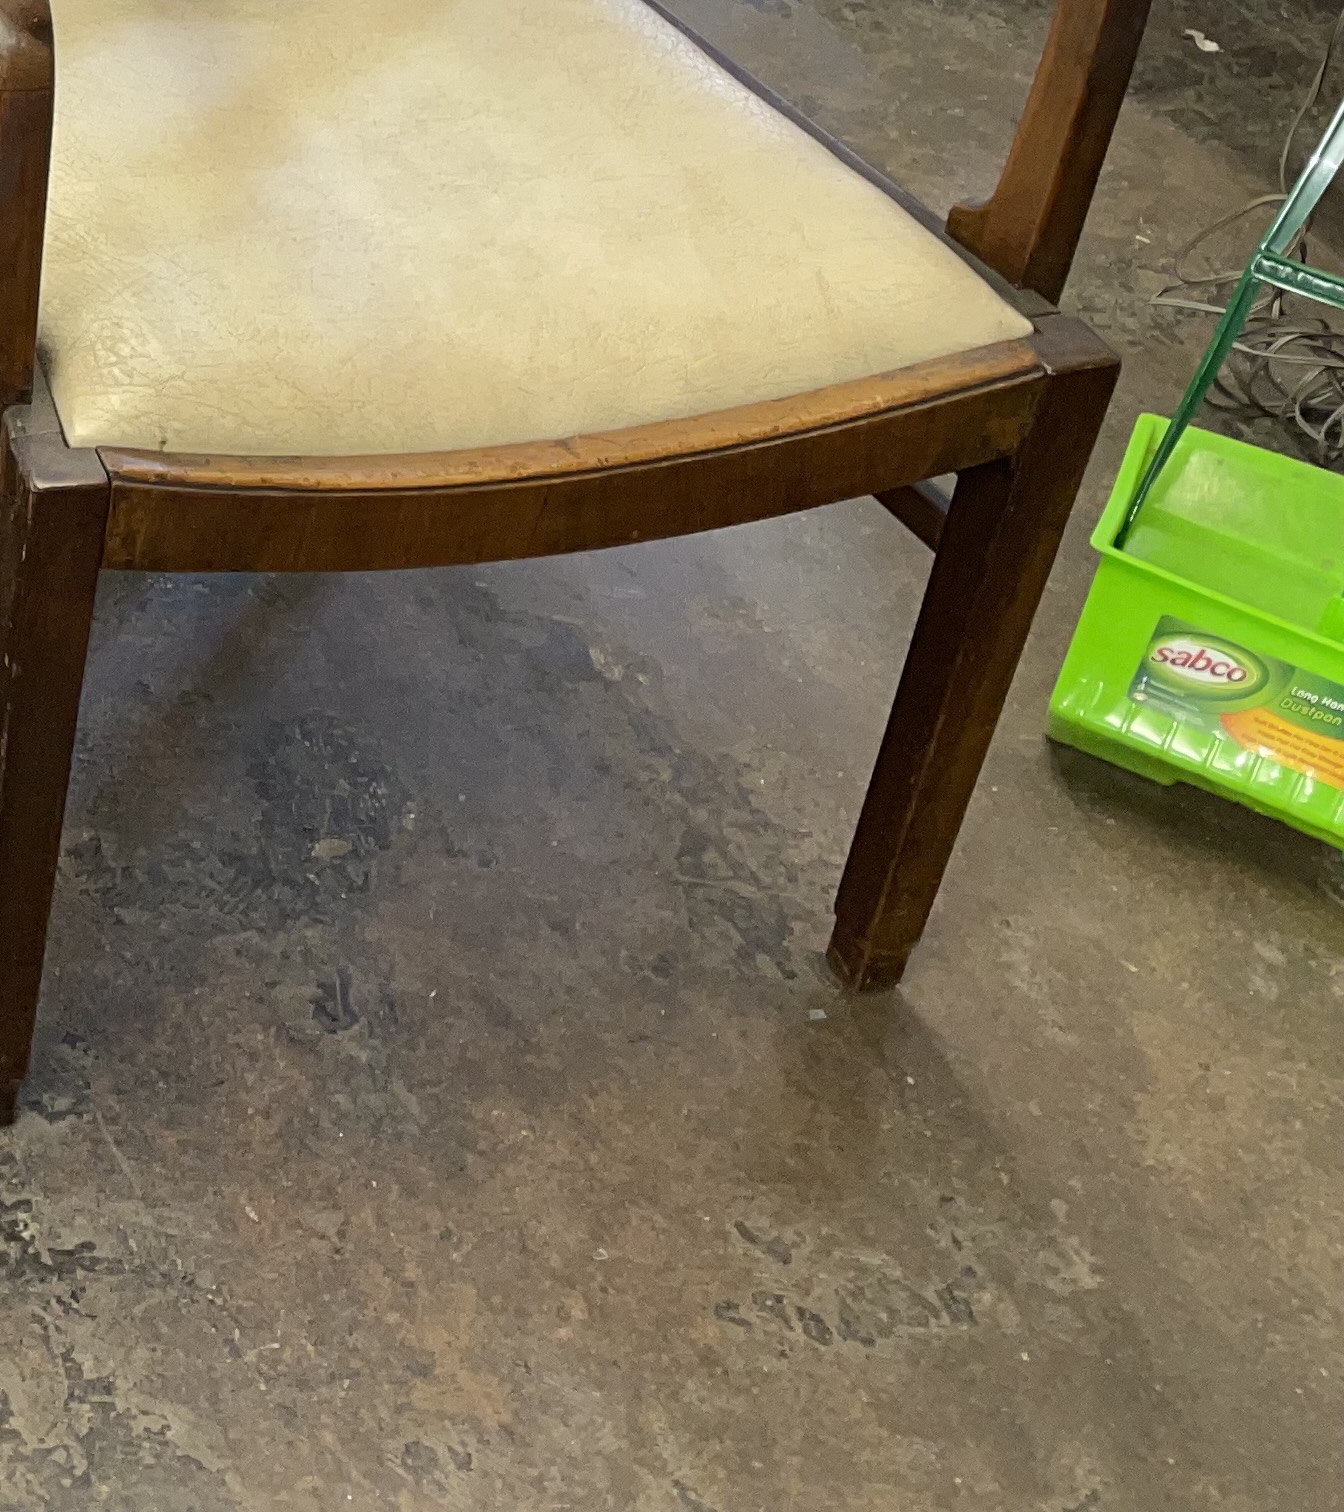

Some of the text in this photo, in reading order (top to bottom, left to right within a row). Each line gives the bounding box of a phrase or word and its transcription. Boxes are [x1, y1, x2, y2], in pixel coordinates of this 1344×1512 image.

[1150, 647, 1248, 683] sabco
[1290, 685, 1319, 704] Long
[1280, 697, 1343, 726] Dustpan
